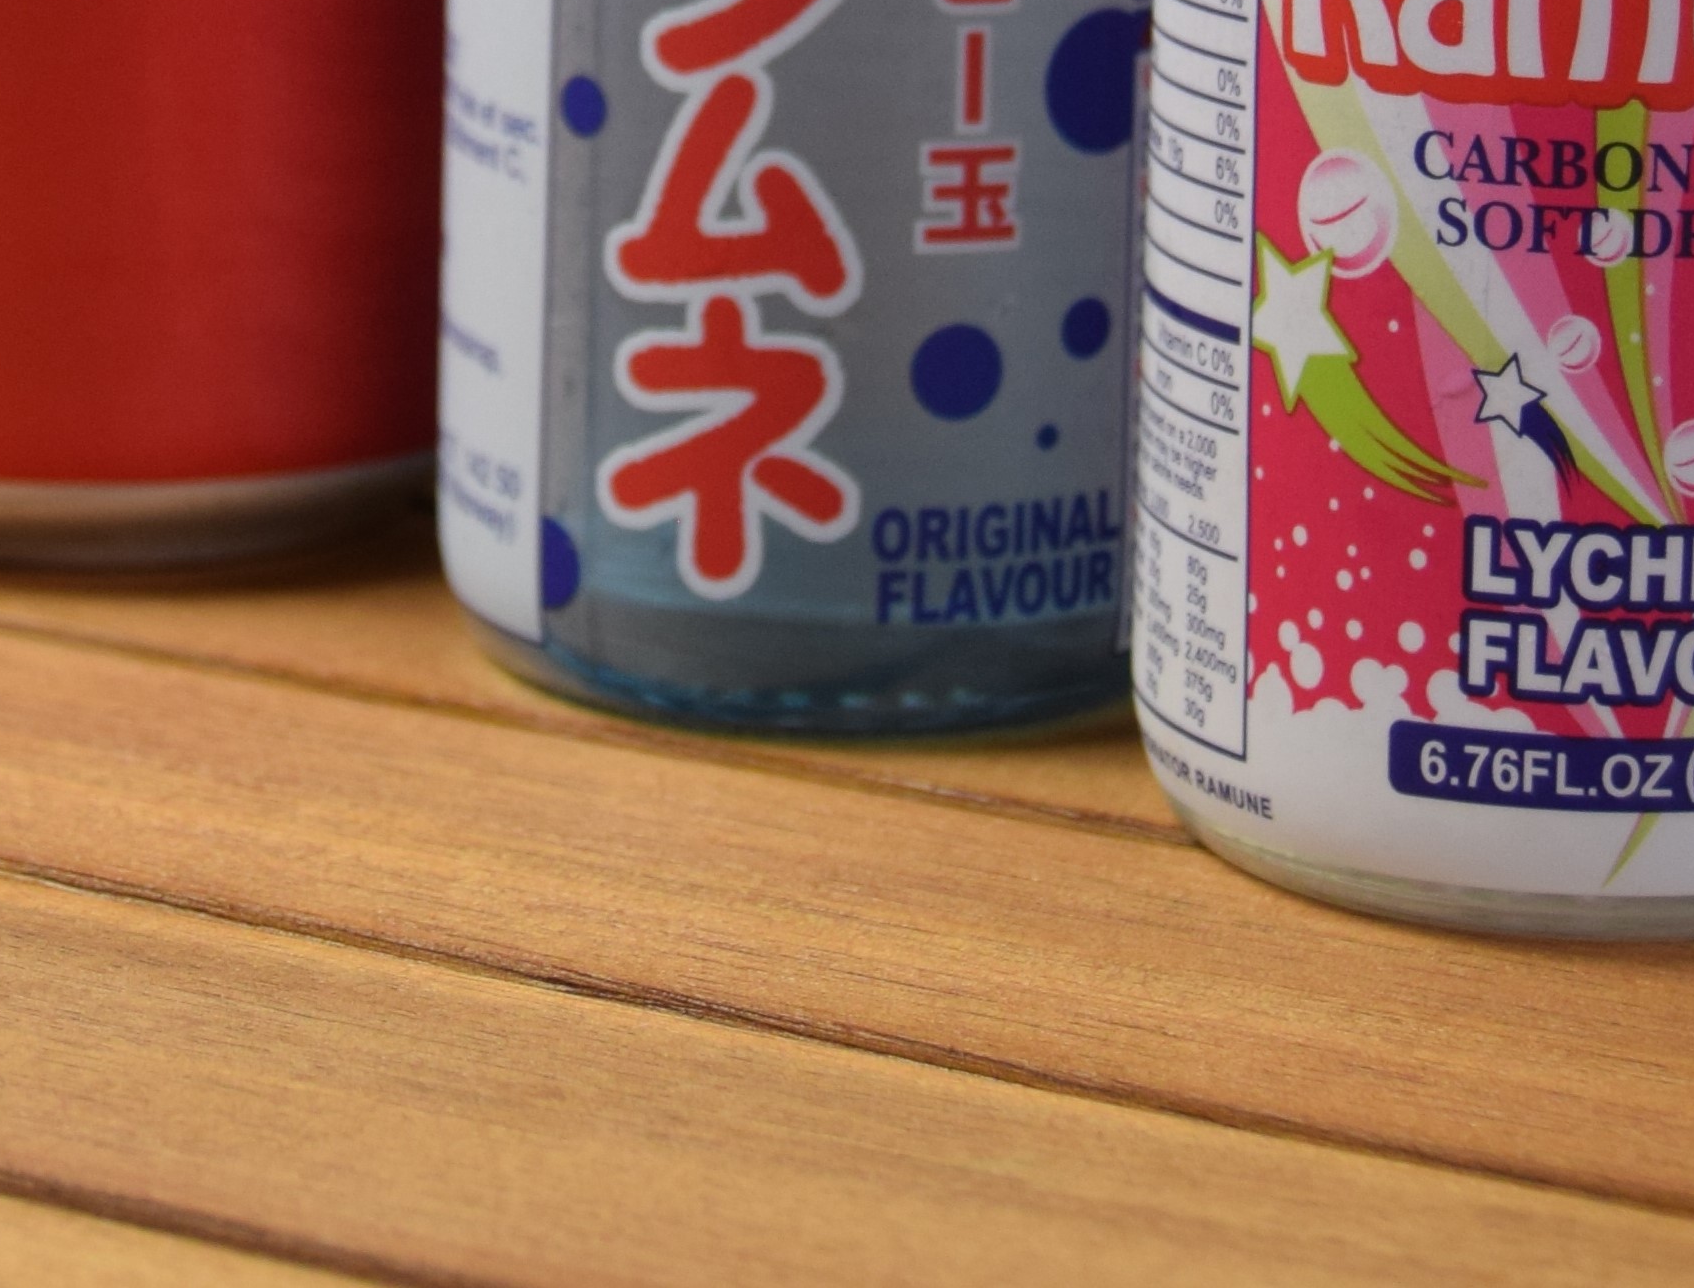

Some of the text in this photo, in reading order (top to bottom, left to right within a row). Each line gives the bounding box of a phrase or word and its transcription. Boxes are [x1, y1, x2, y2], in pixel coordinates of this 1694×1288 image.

[1435, 198, 1617, 256] SOFT
[871, 489, 1121, 563] ORIGINAL
[876, 549, 1113, 625] FLAVOUR
[1194, 768, 1274, 821] RAMUNE
[1418, 737, 1675, 800] 6.76FL.OZ
